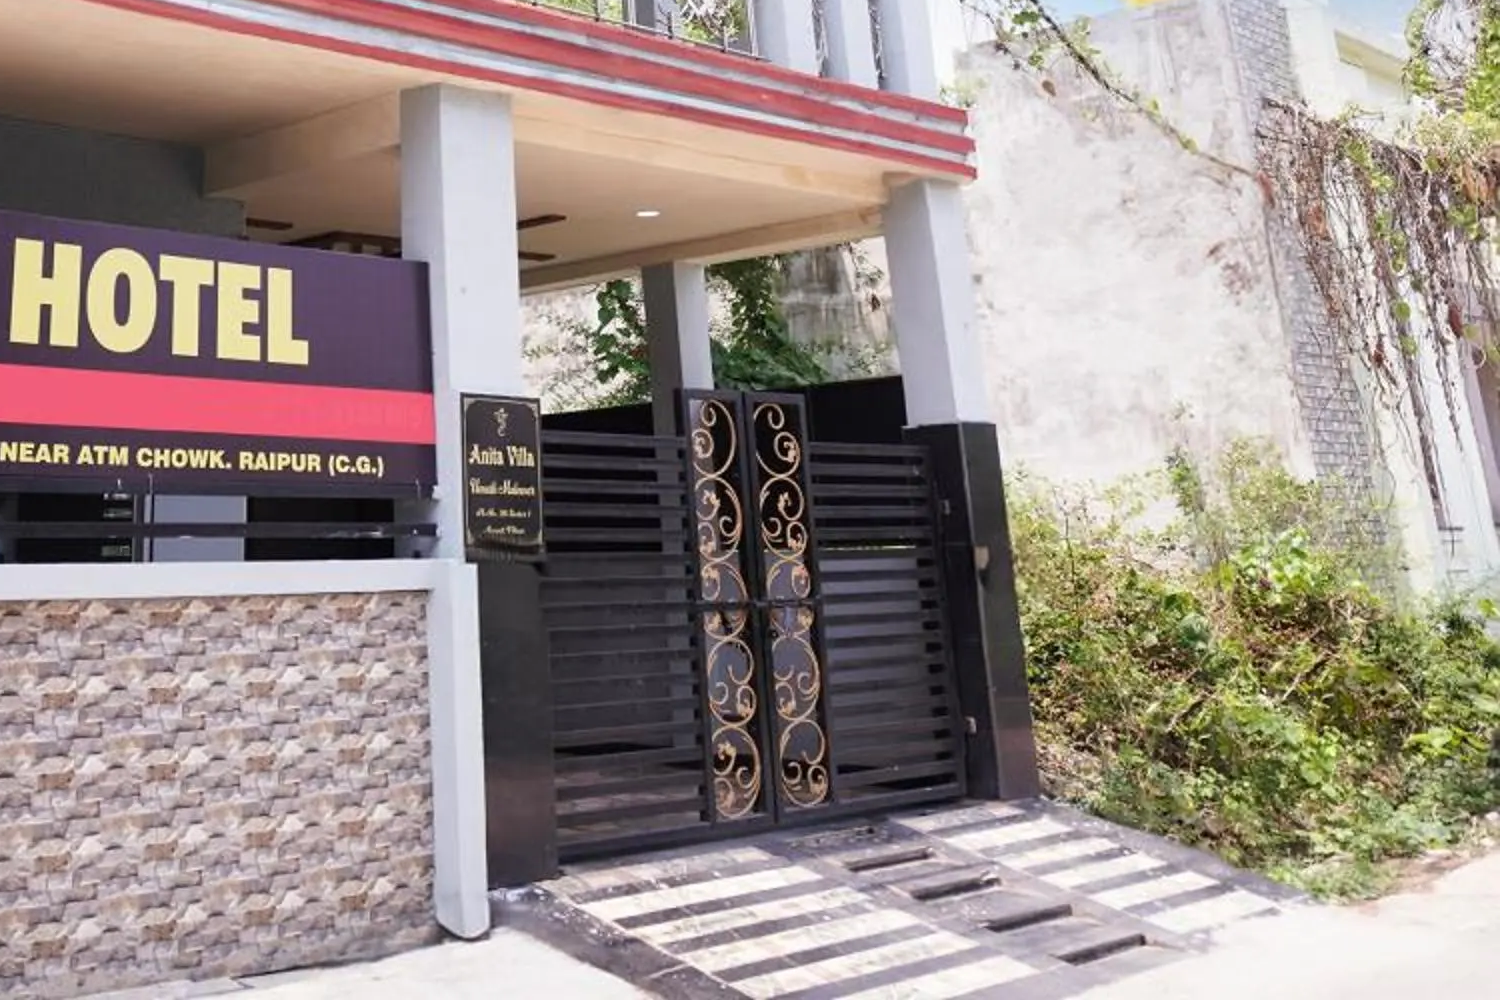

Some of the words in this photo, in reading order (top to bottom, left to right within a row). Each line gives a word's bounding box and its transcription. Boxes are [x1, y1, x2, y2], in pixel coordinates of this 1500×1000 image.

[9, 237, 309, 366] HOTEL
[0, 441, 70, 465] NEAR
[76, 444, 129, 466] ATM
[135, 447, 233, 470] CHOWK.
[239, 451, 322, 473] RAIPUR
[328, 454, 384, 478] (C.G.)
[469, 443, 504, 467] Anita
[506, 445, 536, 467] Villa
